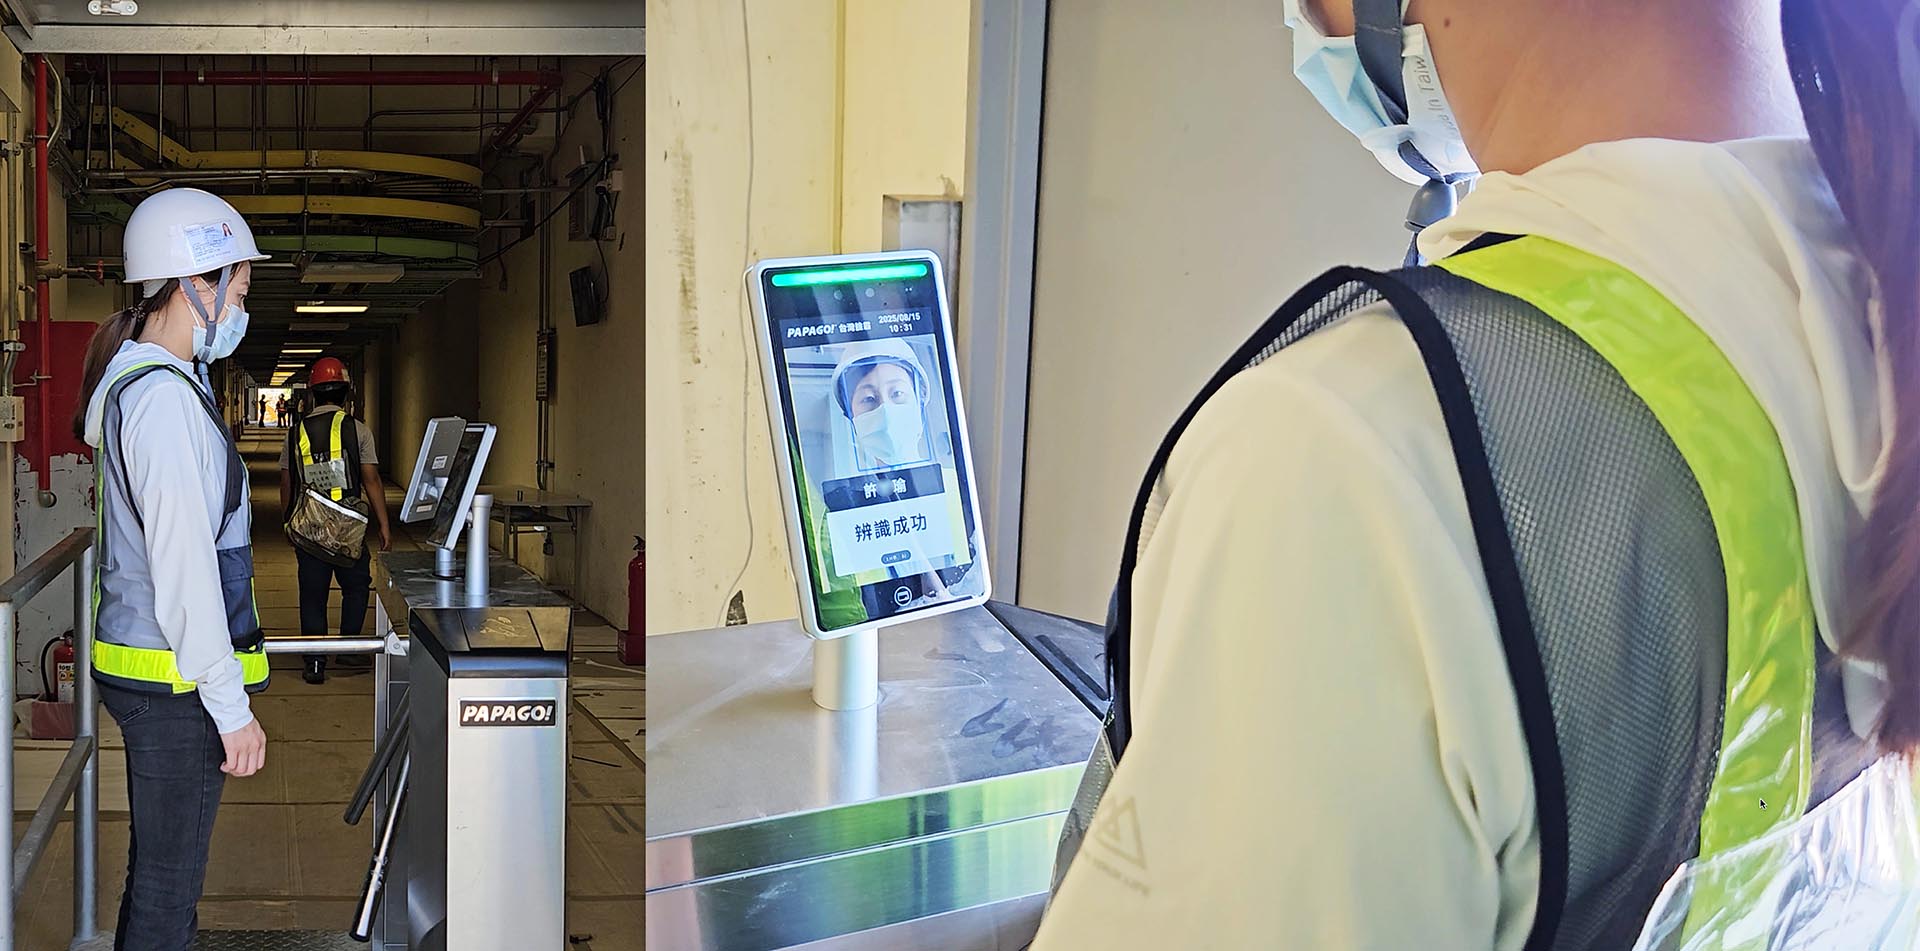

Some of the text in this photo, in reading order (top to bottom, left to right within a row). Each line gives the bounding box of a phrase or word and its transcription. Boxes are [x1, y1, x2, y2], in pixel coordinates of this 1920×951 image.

[878, 312, 921, 324] 2025/08/15
[787, 324, 835, 338] PAPAGO!
[889, 323, 913, 333] 10:31
[863, 478, 907, 499] 許瑜
[854, 512, 928, 543] 辨識成功
[462, 705, 553, 722] PAPAGO!
